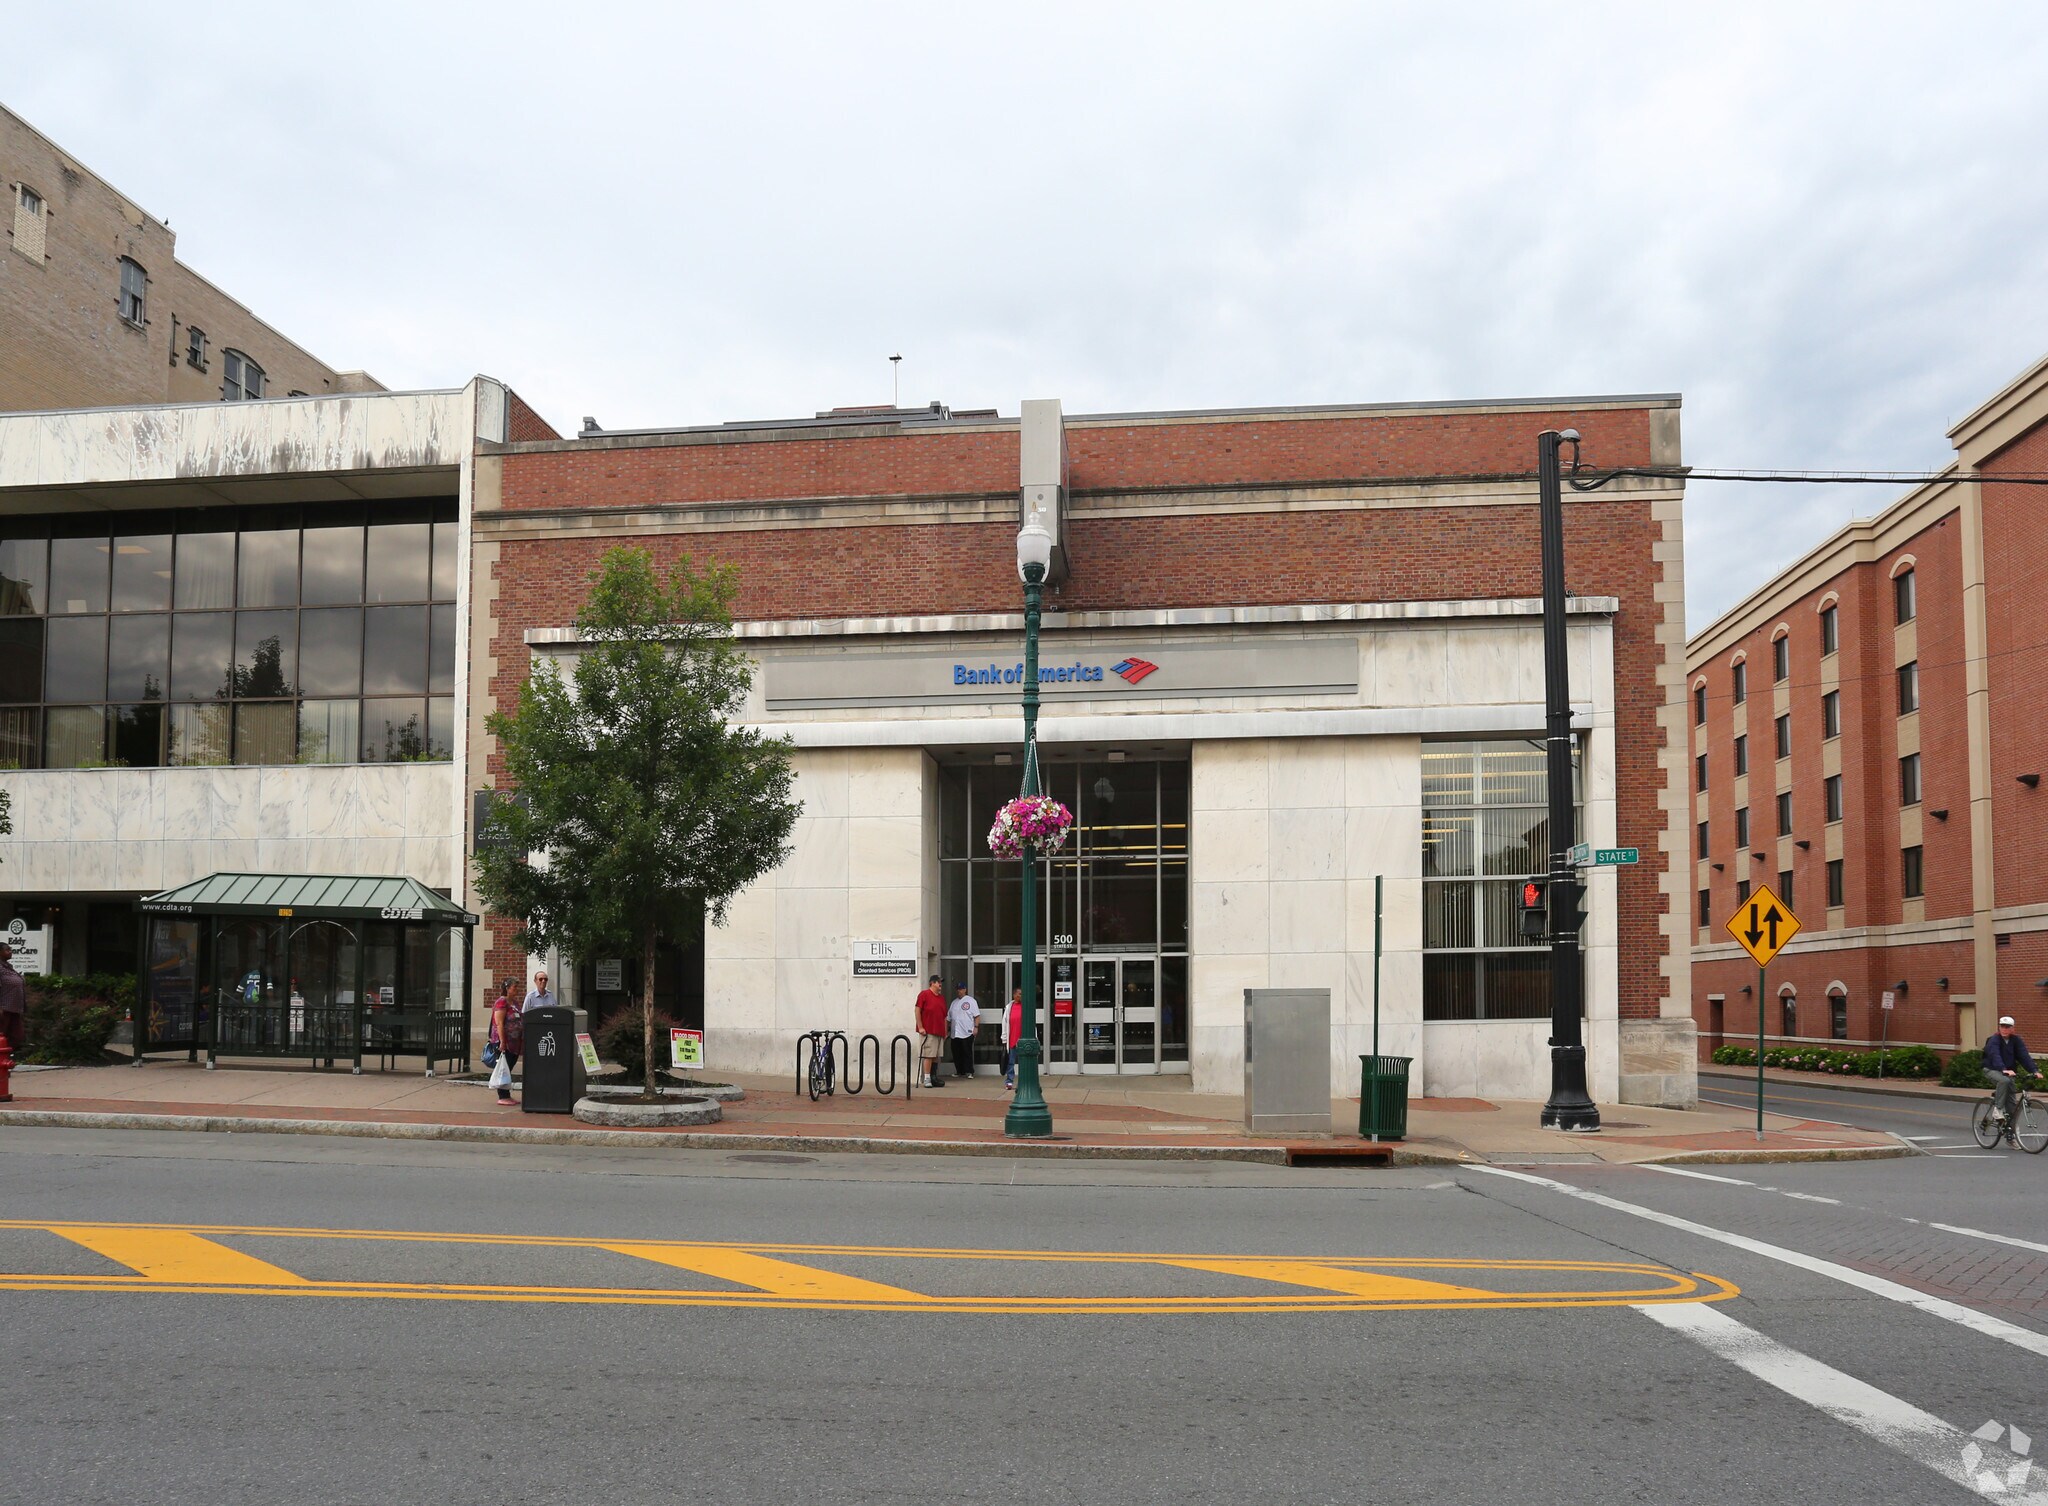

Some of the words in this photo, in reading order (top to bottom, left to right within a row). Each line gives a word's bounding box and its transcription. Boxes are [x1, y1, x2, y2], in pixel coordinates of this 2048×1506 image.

[953, 664, 1001, 684] Bank
[1003, 663, 1024, 683] of
[1038, 662, 1103, 682] merica
[1599, 851, 1627, 861] STATE
[142, 904, 193, 913] www.cdta.org
[381, 907, 423, 919] CDTA
[8, 937, 26, 946] Eddy
[1054, 934, 1073, 944] 500
[871, 943, 893, 955] Ellis
